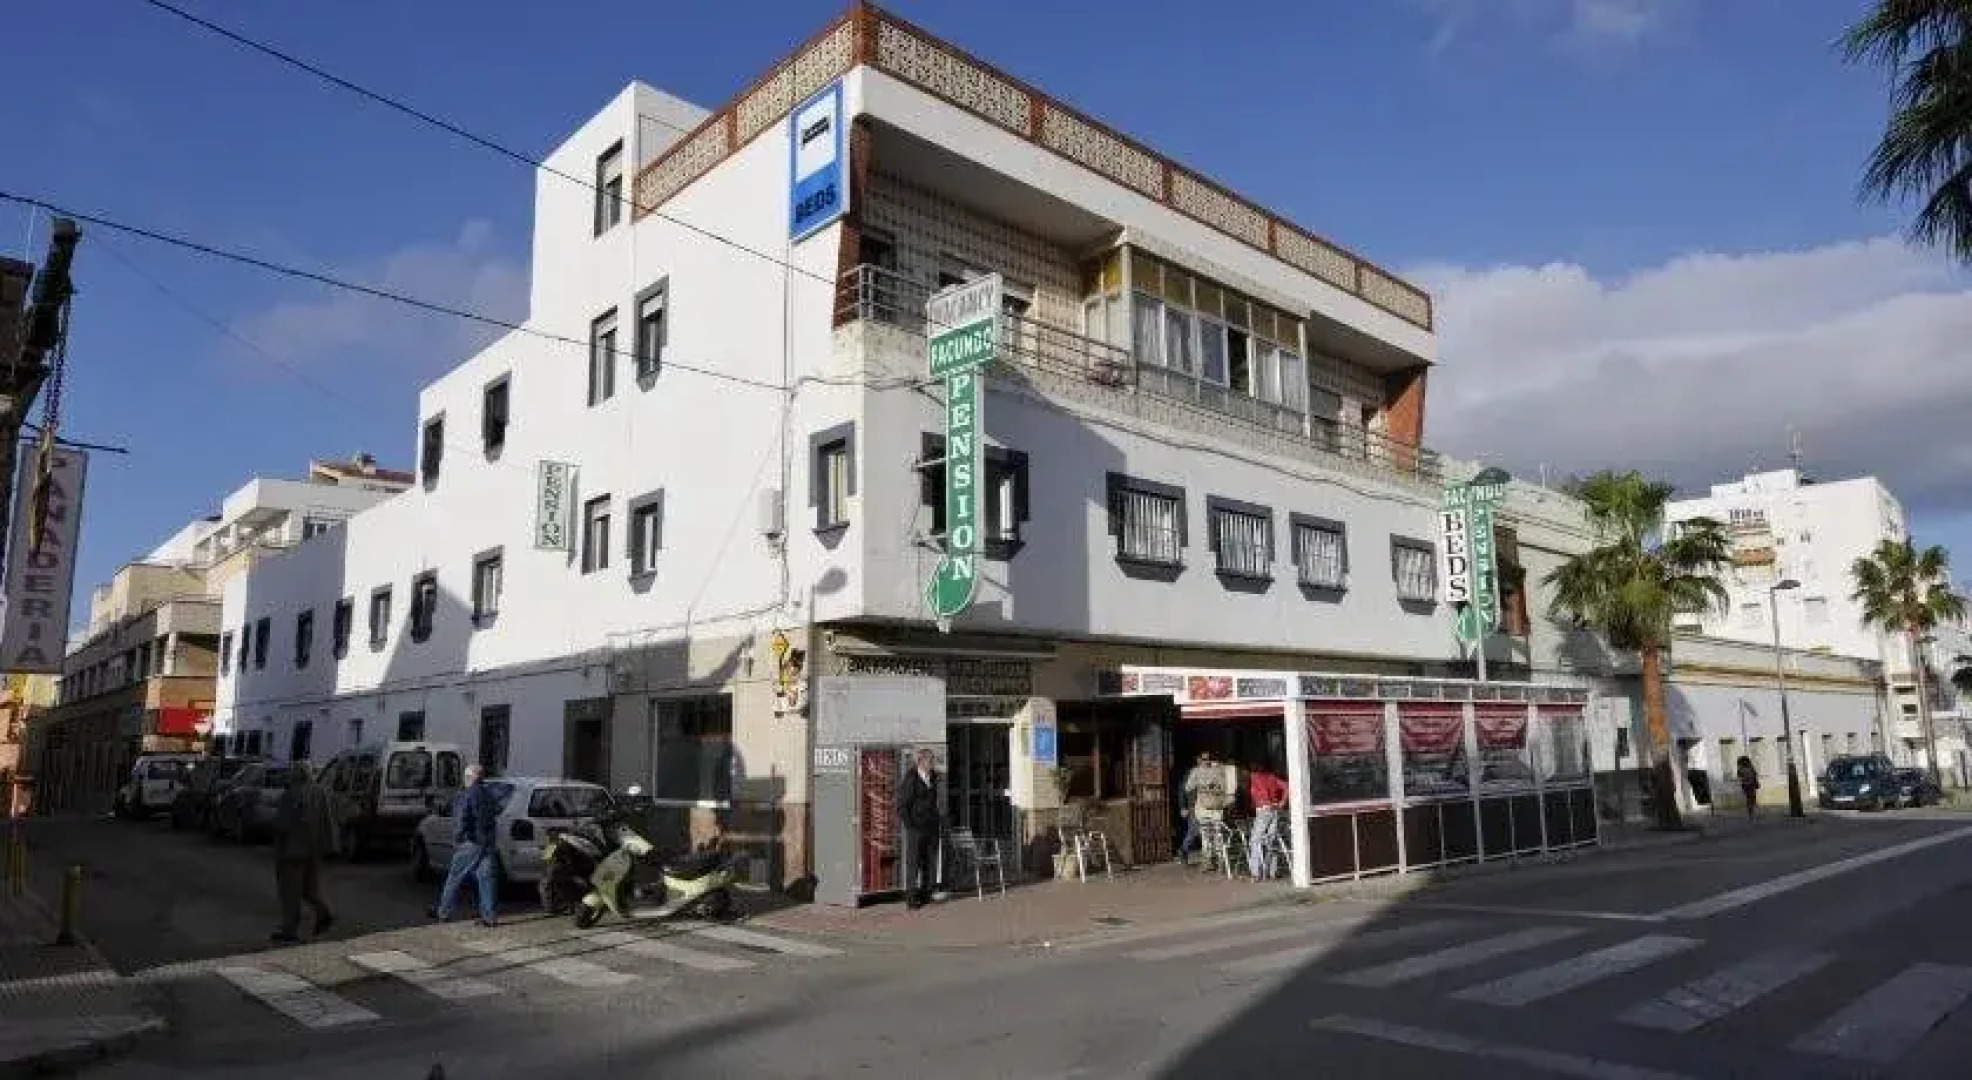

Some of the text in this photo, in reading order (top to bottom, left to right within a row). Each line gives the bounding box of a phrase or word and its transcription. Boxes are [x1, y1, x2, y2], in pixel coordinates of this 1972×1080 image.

[796, 182, 836, 224] BEDS
[931, 326, 992, 367] FACUNDO
[542, 464, 561, 546] PENSION
[952, 375, 974, 579] PENSION
[1445, 512, 1467, 597] BEDS
